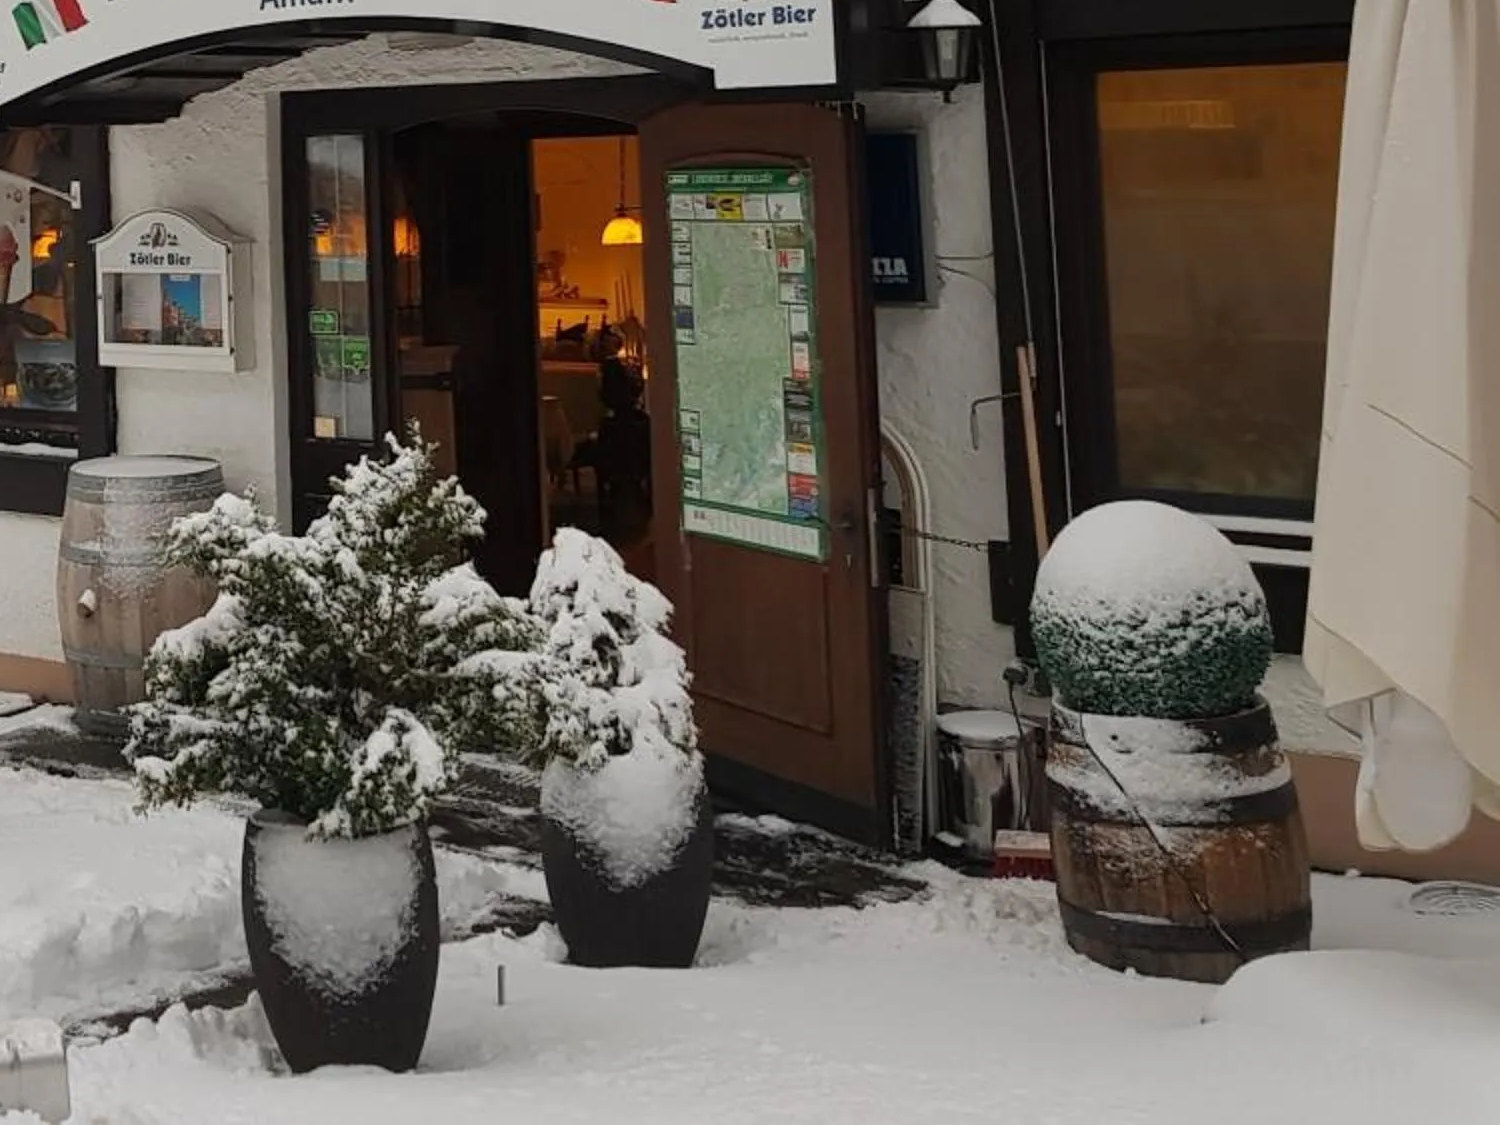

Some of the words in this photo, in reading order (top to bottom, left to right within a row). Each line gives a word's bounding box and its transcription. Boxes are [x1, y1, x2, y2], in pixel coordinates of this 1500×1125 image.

[700, 8, 767, 30] Zötler
[772, 4, 817, 25] Bier
[129, 252, 166, 266] Zötler
[167, 252, 192, 266] Bier
